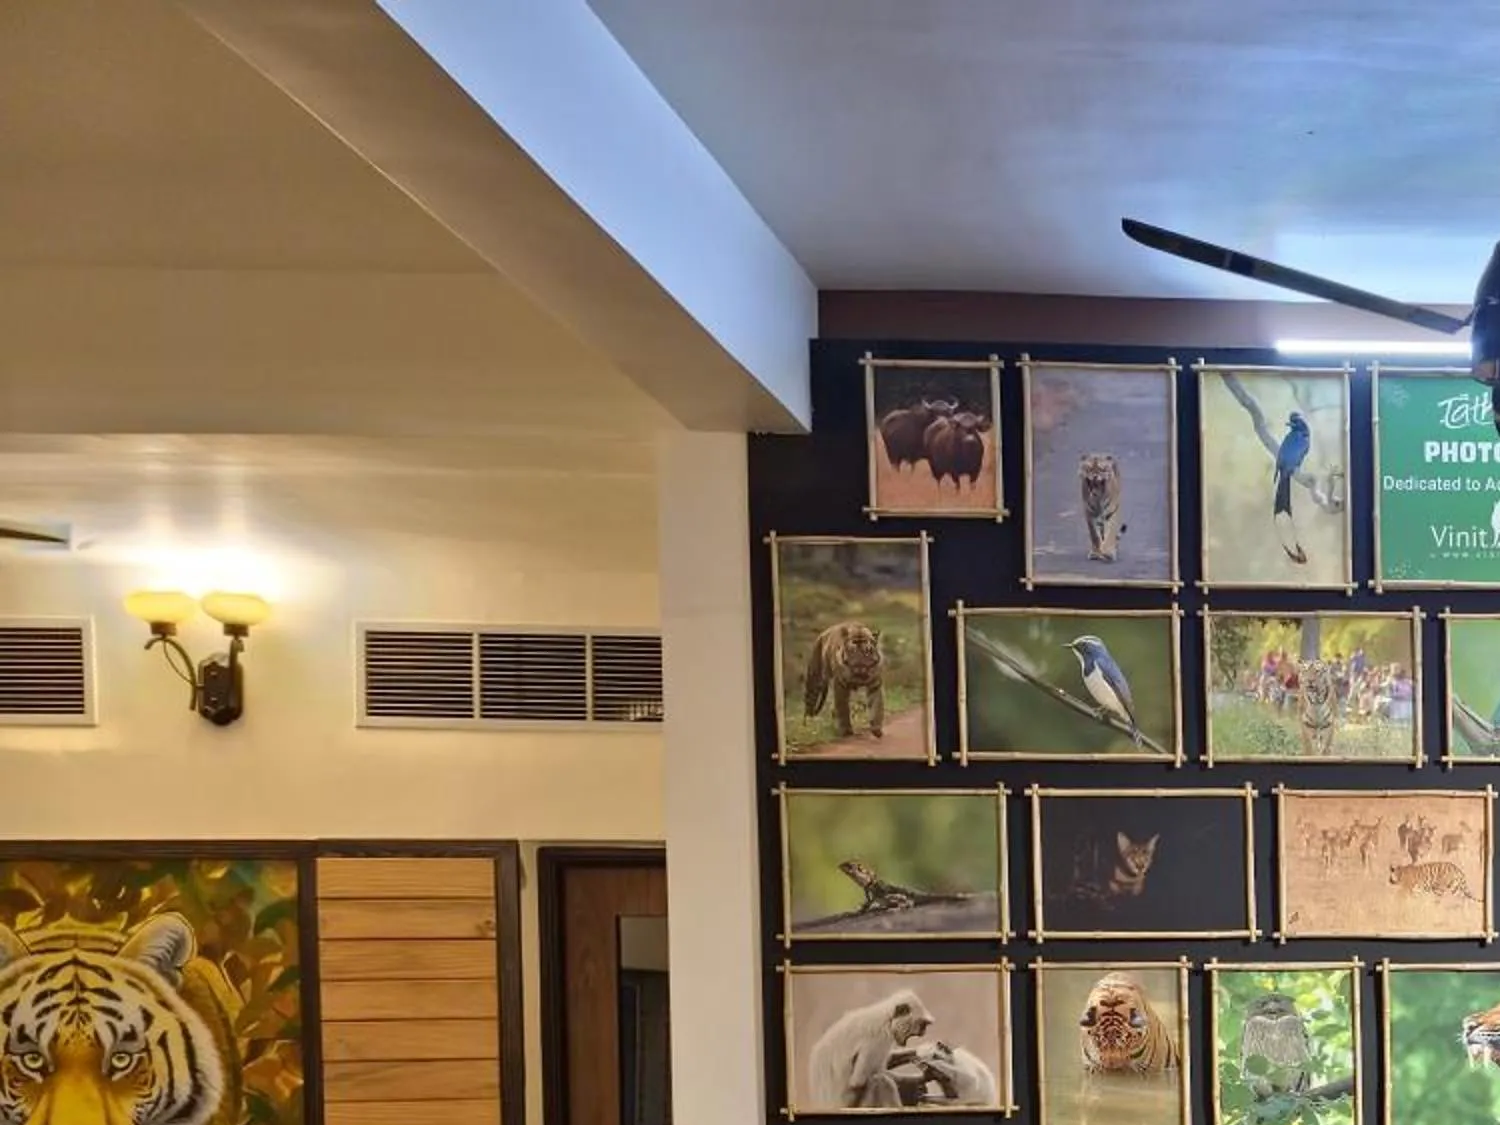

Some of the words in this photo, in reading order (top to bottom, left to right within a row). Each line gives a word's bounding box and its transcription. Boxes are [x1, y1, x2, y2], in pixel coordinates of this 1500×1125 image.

[1383, 475, 1461, 491] Dedicated
[1466, 476, 1481, 491] to
[1430, 524, 1488, 548] Vinit
